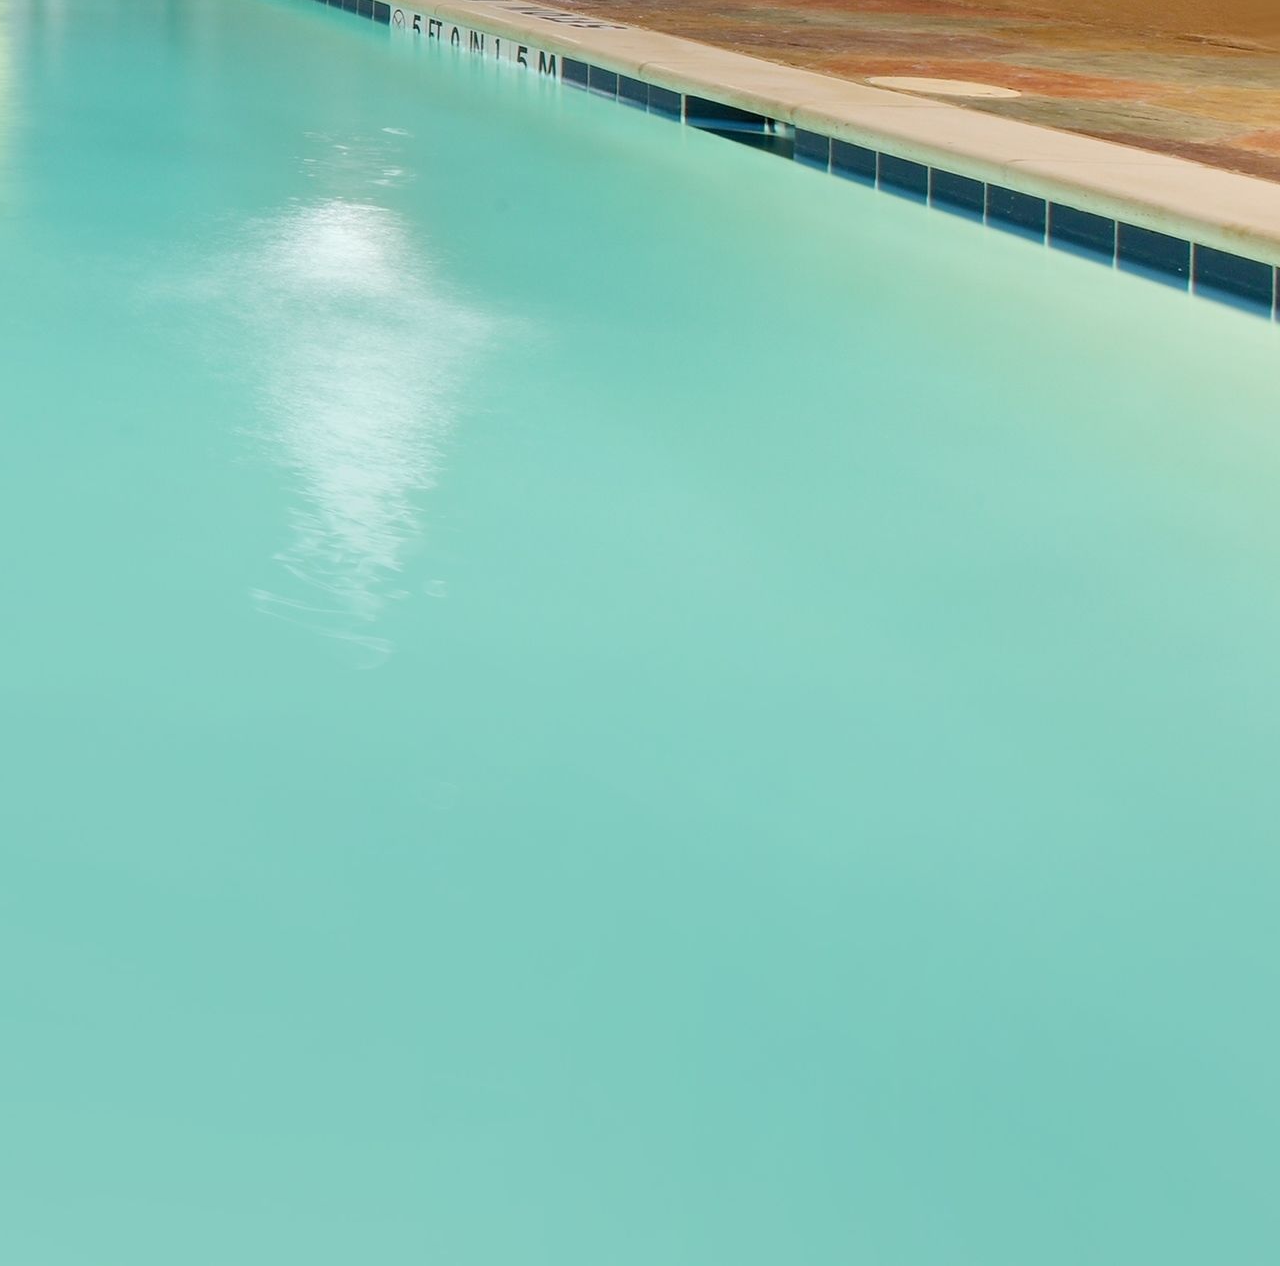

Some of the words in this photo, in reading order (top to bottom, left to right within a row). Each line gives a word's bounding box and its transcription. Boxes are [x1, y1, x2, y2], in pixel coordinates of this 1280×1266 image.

[413, 14, 421, 34] 5
[428, 18, 443, 42] FT
[470, 30, 484, 53] IN
[517, 45, 528, 69] 5
[539, 50, 557, 78] M
